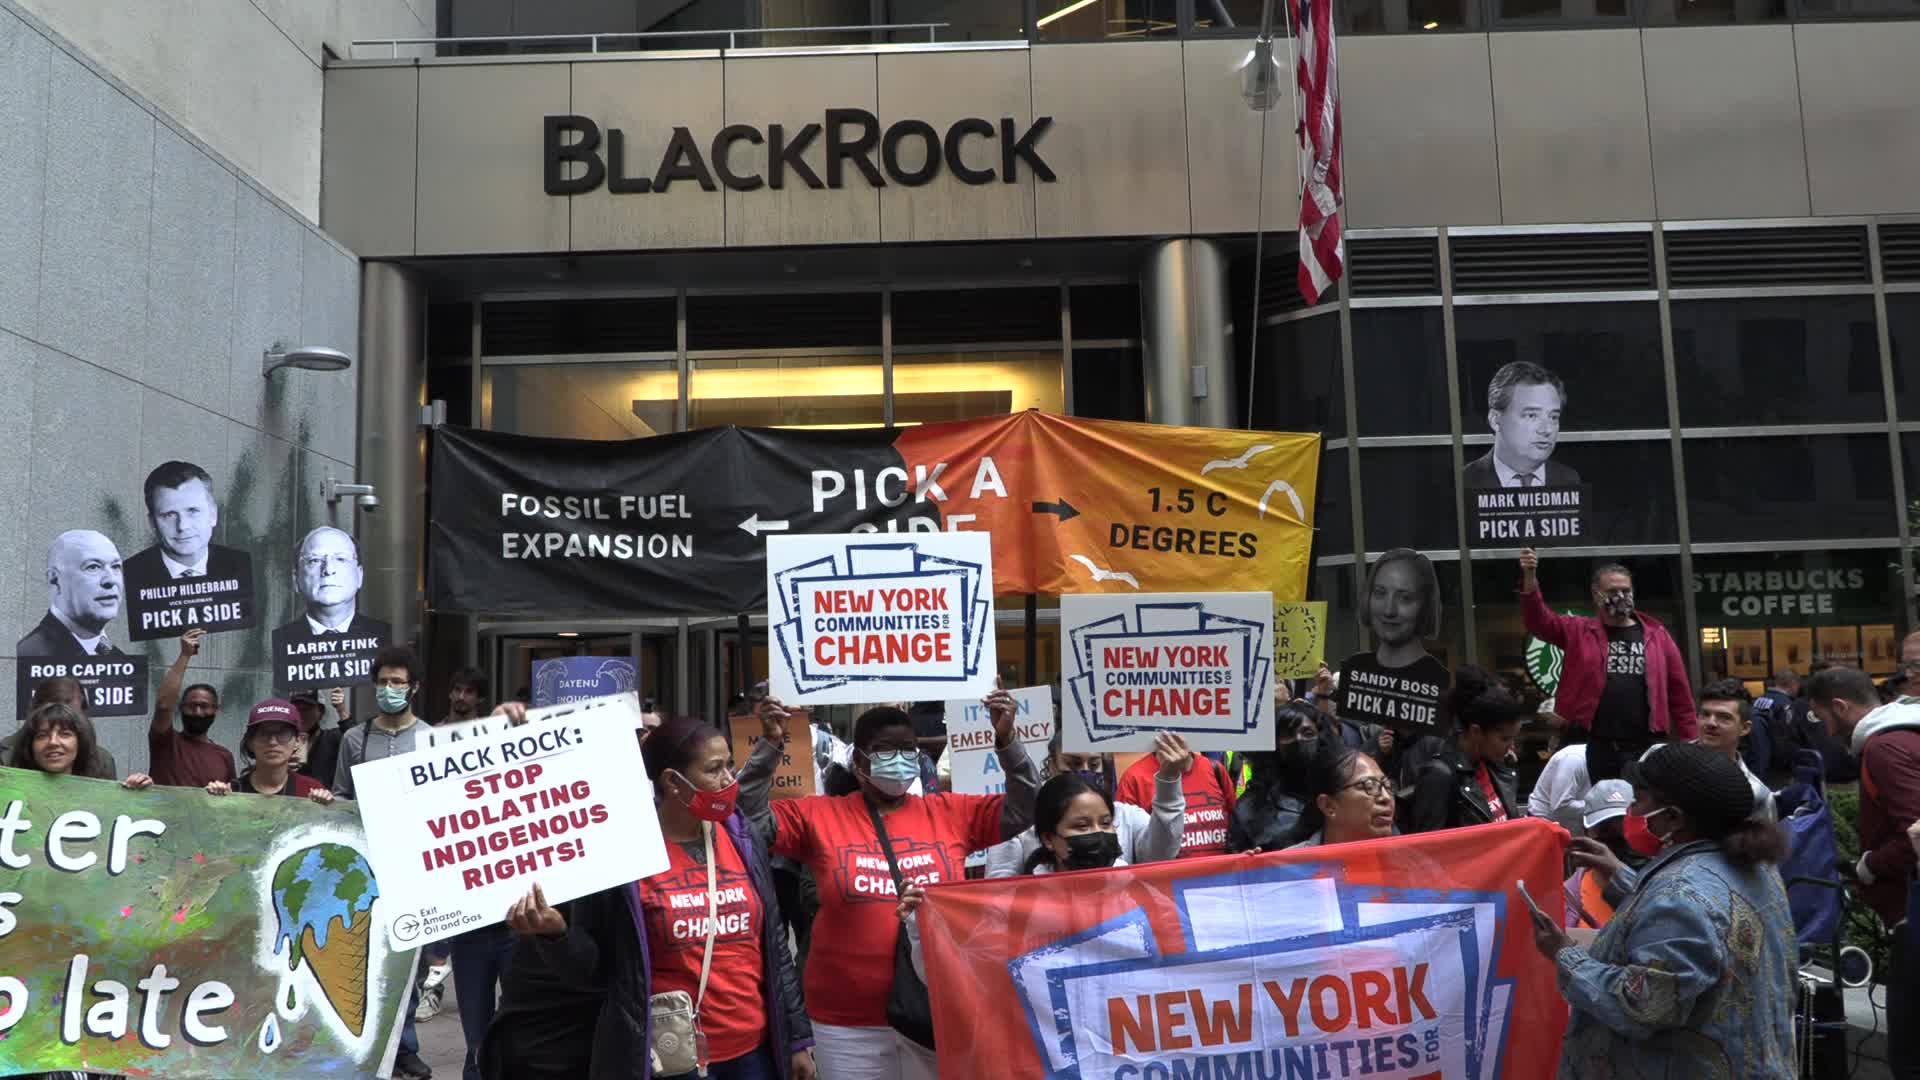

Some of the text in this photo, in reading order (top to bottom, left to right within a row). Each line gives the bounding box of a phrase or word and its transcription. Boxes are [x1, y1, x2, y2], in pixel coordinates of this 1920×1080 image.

[812, 456, 1008, 512] PICK A
[502, 493, 692, 519] FOSSIL FUEL
[1148, 487, 1228, 517] 1.5 C
[1478, 491, 1579, 508] MARK WIEDMAN
[1480, 518, 1579, 538] PICK A SIDE
[502, 533, 693, 559] EXPANSION
[1109, 523, 1258, 558] DEGREES
[140, 579, 238, 600] PHILLIP HILDEBRAND
[1692, 569, 1864, 592] STARBUCKS
[814, 588, 948, 613] NEW YORK
[1722, 594, 1832, 616] COFFEE
[142, 602, 241, 629] PICK A SIDE
[815, 615, 940, 632] COMMUNITIES
[287, 637, 378, 655] LARRY FINK
[814, 633, 952, 666] CHANGE
[1104, 645, 1229, 668] NEW YORK
[31, 663, 134, 677] ROB CAPITO
[287, 659, 375, 681] PICK A SID
[1607, 656, 1645, 675] ESIS
[559, 679, 599, 689] DAYENU
[1106, 671, 1223, 686] COMMUNITIES
[1351, 670, 1397, 688] SANDY
[1401, 680, 1439, 697] BOSS
[95, 687, 133, 705] SIDE
[1103, 688, 1231, 716] CHANGE
[257, 706, 290, 714] SCIENCE
[1347, 692, 1381, 715] PICK
[1386, 700, 1396, 717] A
[1400, 703, 1436, 725] SIDE
[951, 722, 1050, 748] EMERNCY
[411, 747, 494, 786] BLACK
[501, 727, 583, 763] ROCK:
[464, 764, 543, 799] STOP
[426, 780, 591, 839] VIOLATING
[1183, 809, 1224, 824] EW YORK
[422, 804, 609, 871] INDIGENOUS
[1181, 828, 1227, 847] CHANGE
[462, 838, 585, 890] RIGHTS!
[856, 856, 889, 871] NEW
[855, 872, 940, 896] CHAGE
[420, 906, 437, 917] Exit
[670, 892, 705, 908] NEW
[422, 910, 462, 926] Amazon
[424, 913, 482, 935] Oil and Gas
[61, 953, 236, 1048] late
[1107, 963, 1438, 1056] NEW YORK
[1424, 1026, 1441, 1064] FOR
